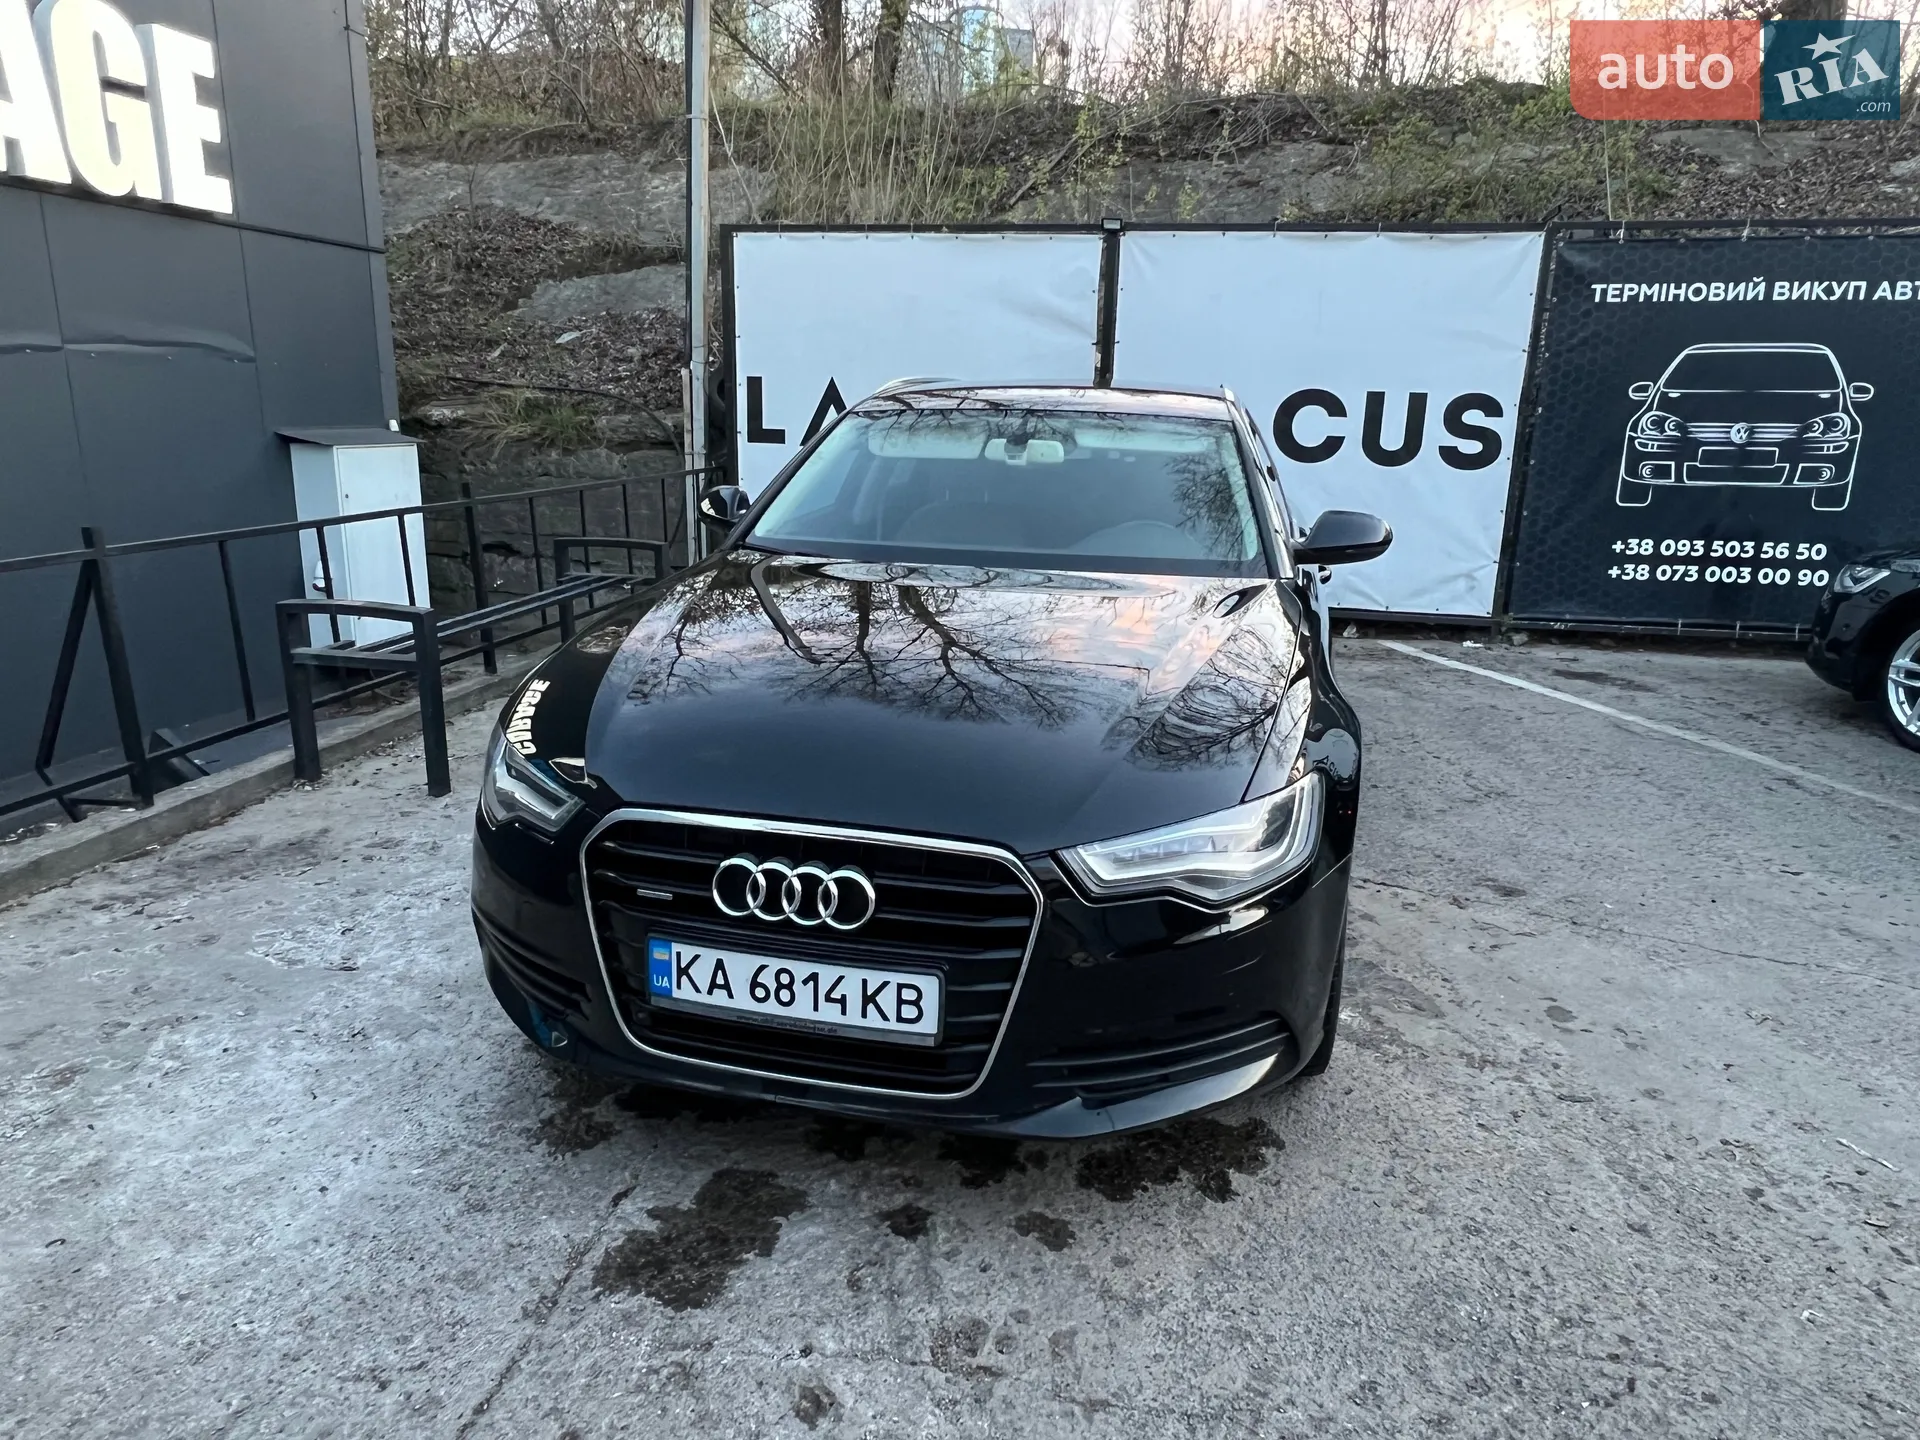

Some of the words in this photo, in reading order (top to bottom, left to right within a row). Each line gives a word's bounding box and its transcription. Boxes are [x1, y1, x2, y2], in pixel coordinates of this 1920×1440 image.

[1591, 277, 1767, 302] ТЕРМІНОВИЙ
[1772, 280, 1868, 301] ВИКУП
[1611, 538, 1655, 556] +38
[1659, 539, 1705, 557] 093
[1709, 540, 1756, 558] 503
[1760, 541, 1790, 559] 56
[1795, 543, 1828, 561] 50
[1607, 563, 1650, 581] +38
[1655, 564, 1700, 582] 073
[1704, 565, 1752, 583] 003
[1757, 567, 1791, 585] 00
[1797, 569, 1830, 587] 90
[653, 975, 670, 990] UA
[675, 950, 735, 1000] KA
[749, 963, 848, 1017] 6814
[860, 977, 924, 1025] KB
